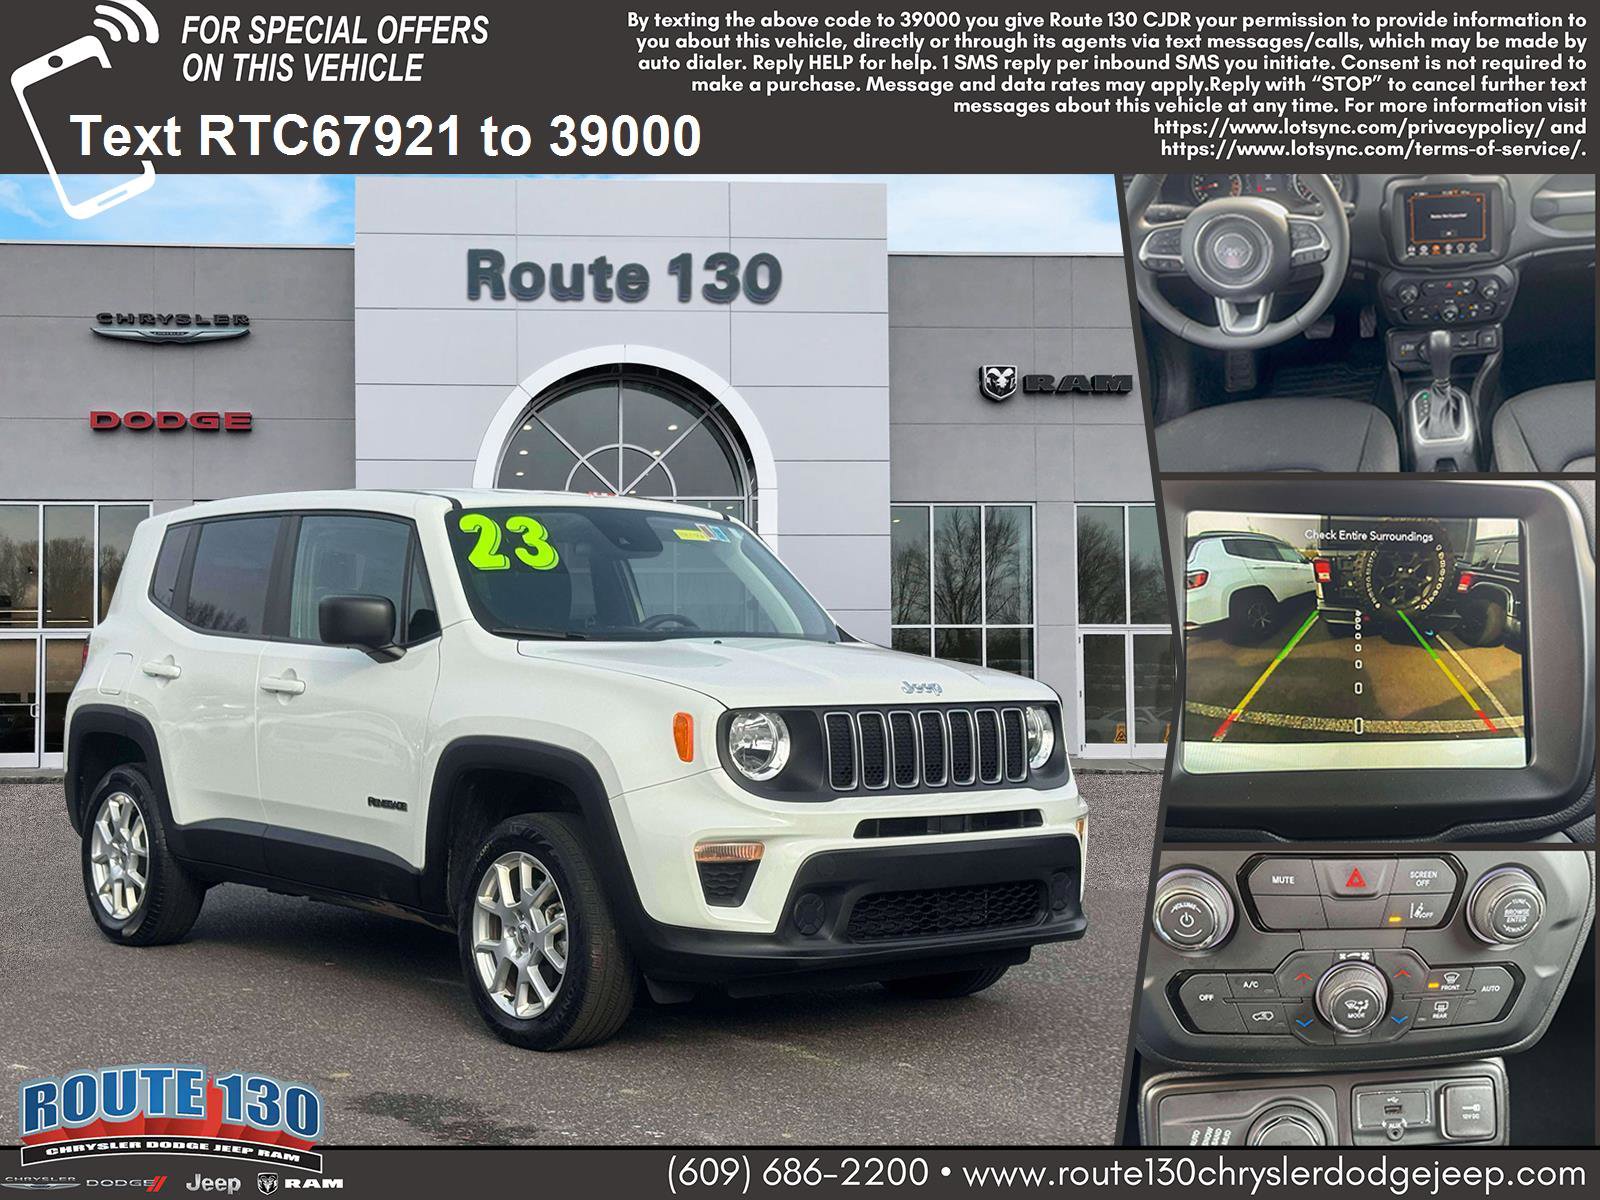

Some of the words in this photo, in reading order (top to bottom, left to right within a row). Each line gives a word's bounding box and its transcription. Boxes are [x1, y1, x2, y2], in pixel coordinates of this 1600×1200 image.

[467, 248, 649, 301] Route
[667, 251, 783, 304] 130
[96, 312, 250, 326] CHRYSLER
[1022, 374, 1134, 394] RAM
[90, 411, 253, 432] DODGE
[459, 513, 560, 571] 23
[1304, 529, 1337, 541] Check
[1339, 530, 1368, 541] Entire
[1369, 530, 1434, 543] Surroundings
[901, 680, 943, 696] Jeep
[1272, 876, 1295, 884] MUTE
[1410, 870, 1438, 879] SCREEN
[1421, 911, 1434, 919] OFF
[1243, 980, 1259, 988] A/C
